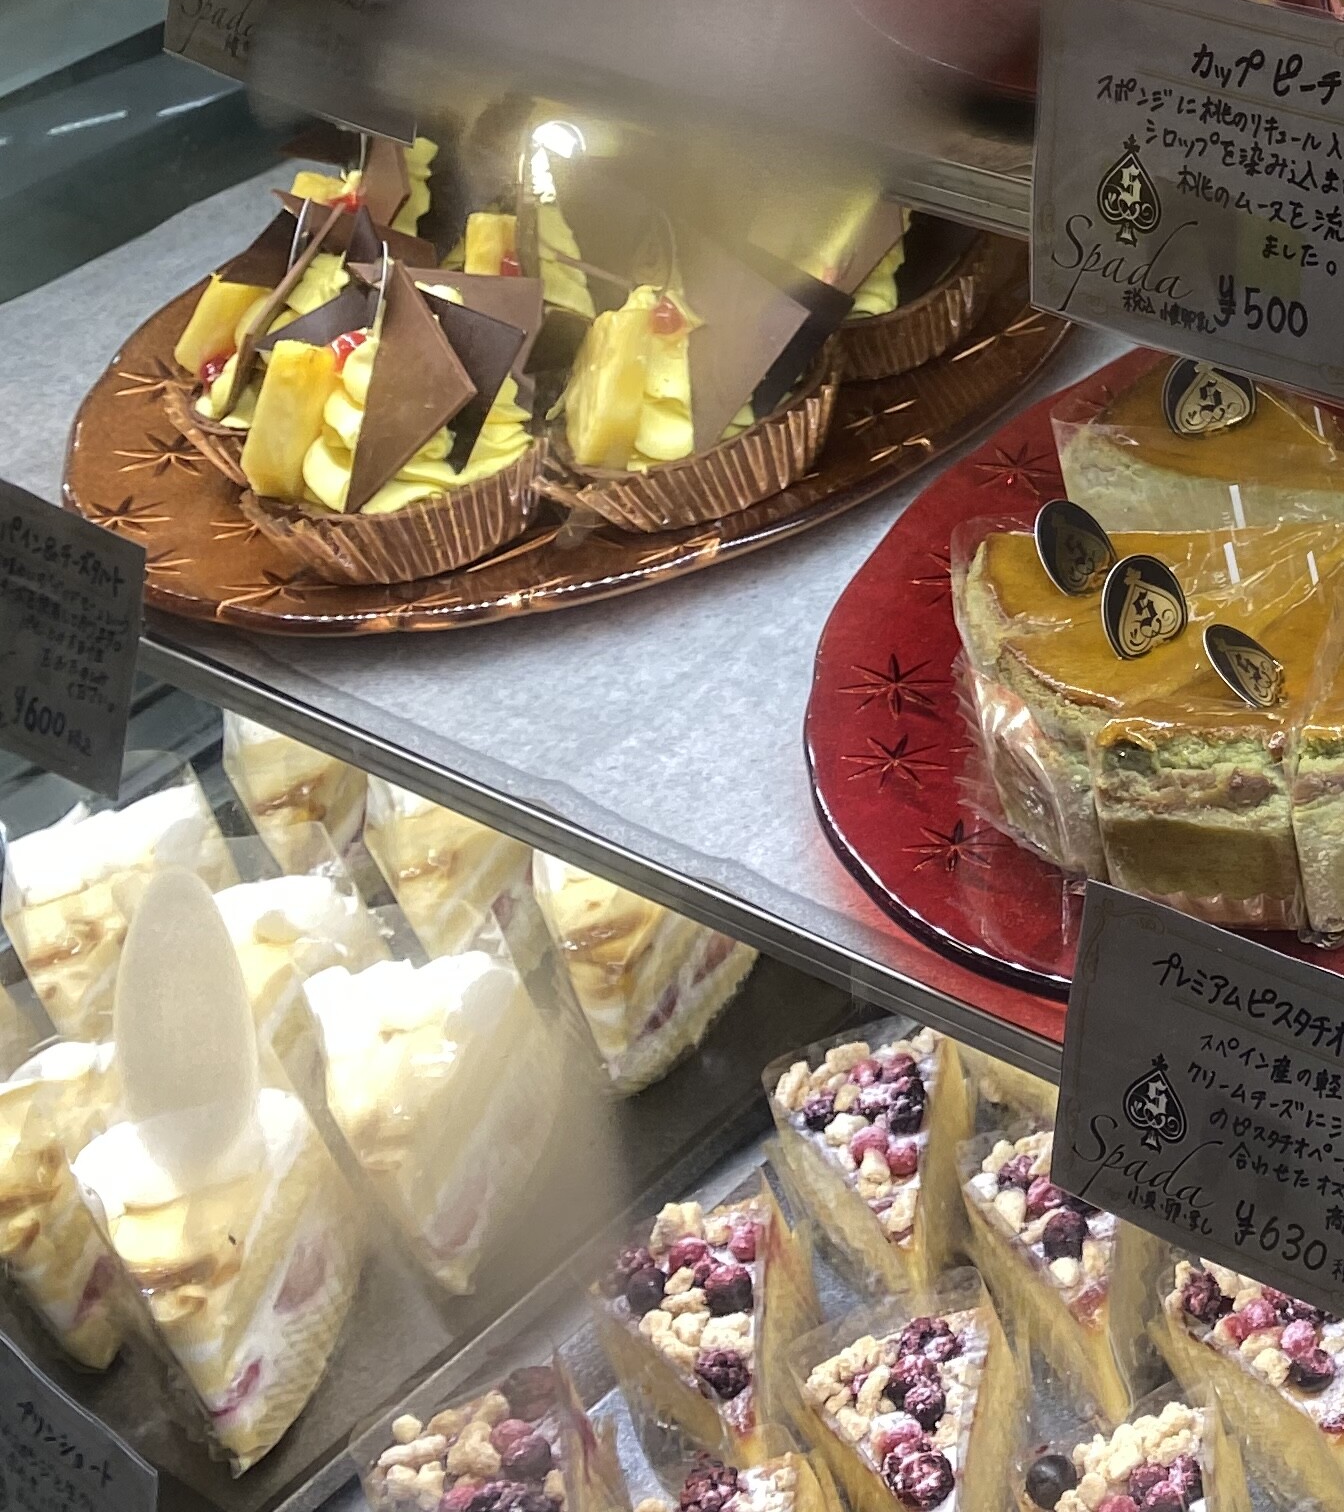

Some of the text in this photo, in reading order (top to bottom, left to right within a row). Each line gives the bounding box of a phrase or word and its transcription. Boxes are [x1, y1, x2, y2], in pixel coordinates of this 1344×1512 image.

[1051, 215, 1198, 311] Spada
[1262, 236, 1337, 276] ました。
[1216, 274, 1308, 337] ¥500
[1073, 1114, 1223, 1207] Spada
[1233, 1200, 1328, 1272] ¥630
